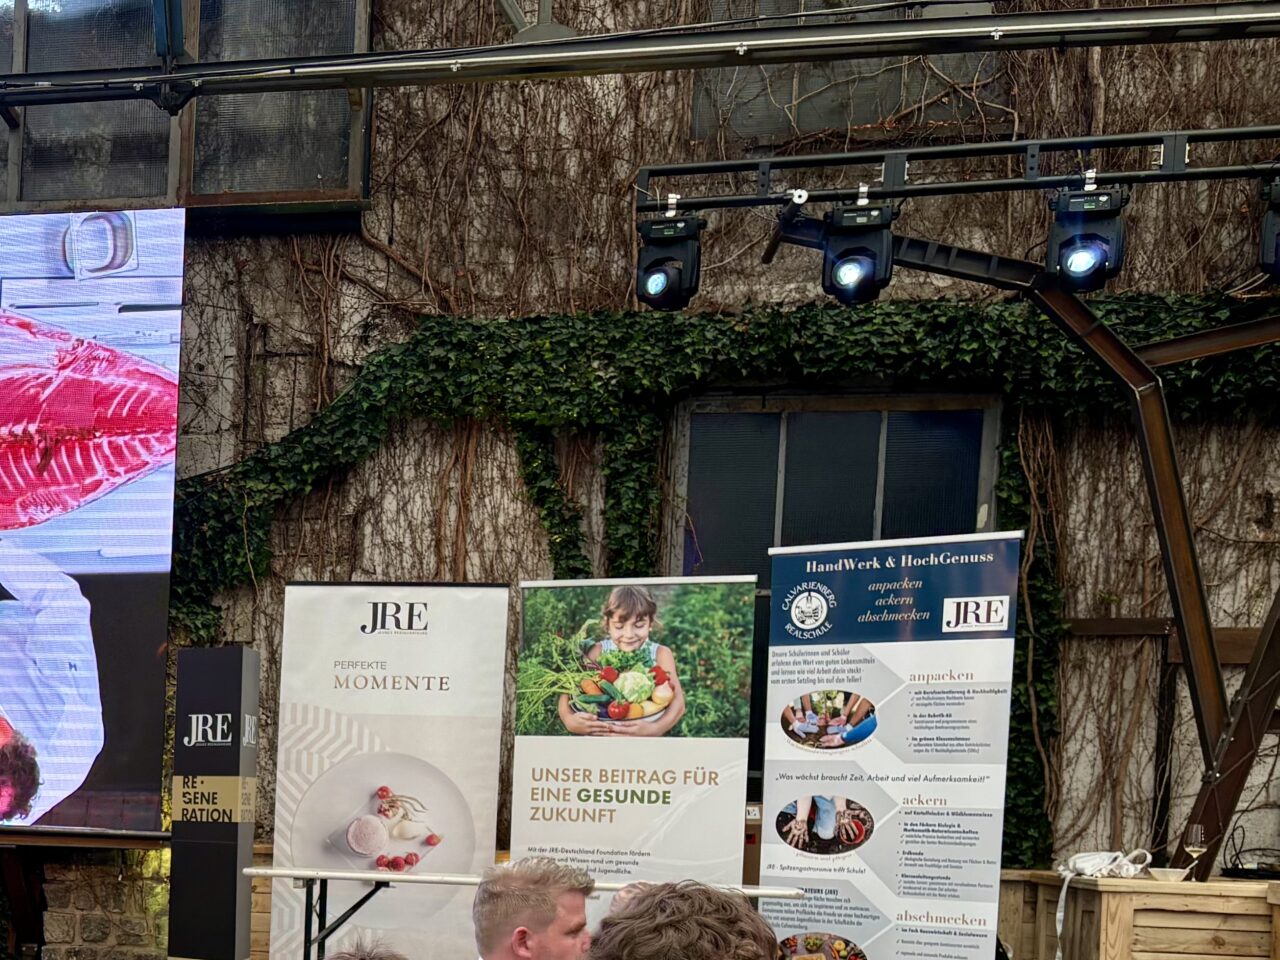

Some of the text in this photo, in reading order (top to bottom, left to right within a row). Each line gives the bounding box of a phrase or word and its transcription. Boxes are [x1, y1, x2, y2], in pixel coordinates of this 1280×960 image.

[806, 552, 994, 573] HandWerk & HochGenuss
[868, 577, 923, 593] anpacken
[781, 581, 837, 611] CALVARIENBERG
[875, 594, 913, 607] ackern
[360, 601, 428, 634] JRE
[857, 609, 930, 623] abschmecken
[946, 599, 1005, 629] JRE
[784, 621, 833, 640] REALSCHULE
[333, 661, 387, 670] PERFEKTE
[334, 674, 451, 691] MOMENTE
[910, 669, 974, 685] anpacken
[183, 713, 233, 747] JRE
[242, 713, 258, 747] JRE
[531, 767, 719, 786] UNSER BEITRAG FÜR
[795, 773, 819, 781] wächst
[821, 773, 848, 782] braucht
[866, 774, 890, 782] Arbeit
[891, 774, 905, 782] und
[907, 774, 921, 782] viel
[182, 792, 218, 805] GENE
[530, 787, 671, 805] EINE GESUNDE
[902, 794, 947, 806] ackern
[181, 808, 233, 822] RATION
[529, 806, 617, 824] ZUKUNFT
[896, 910, 987, 927] abschmecken
